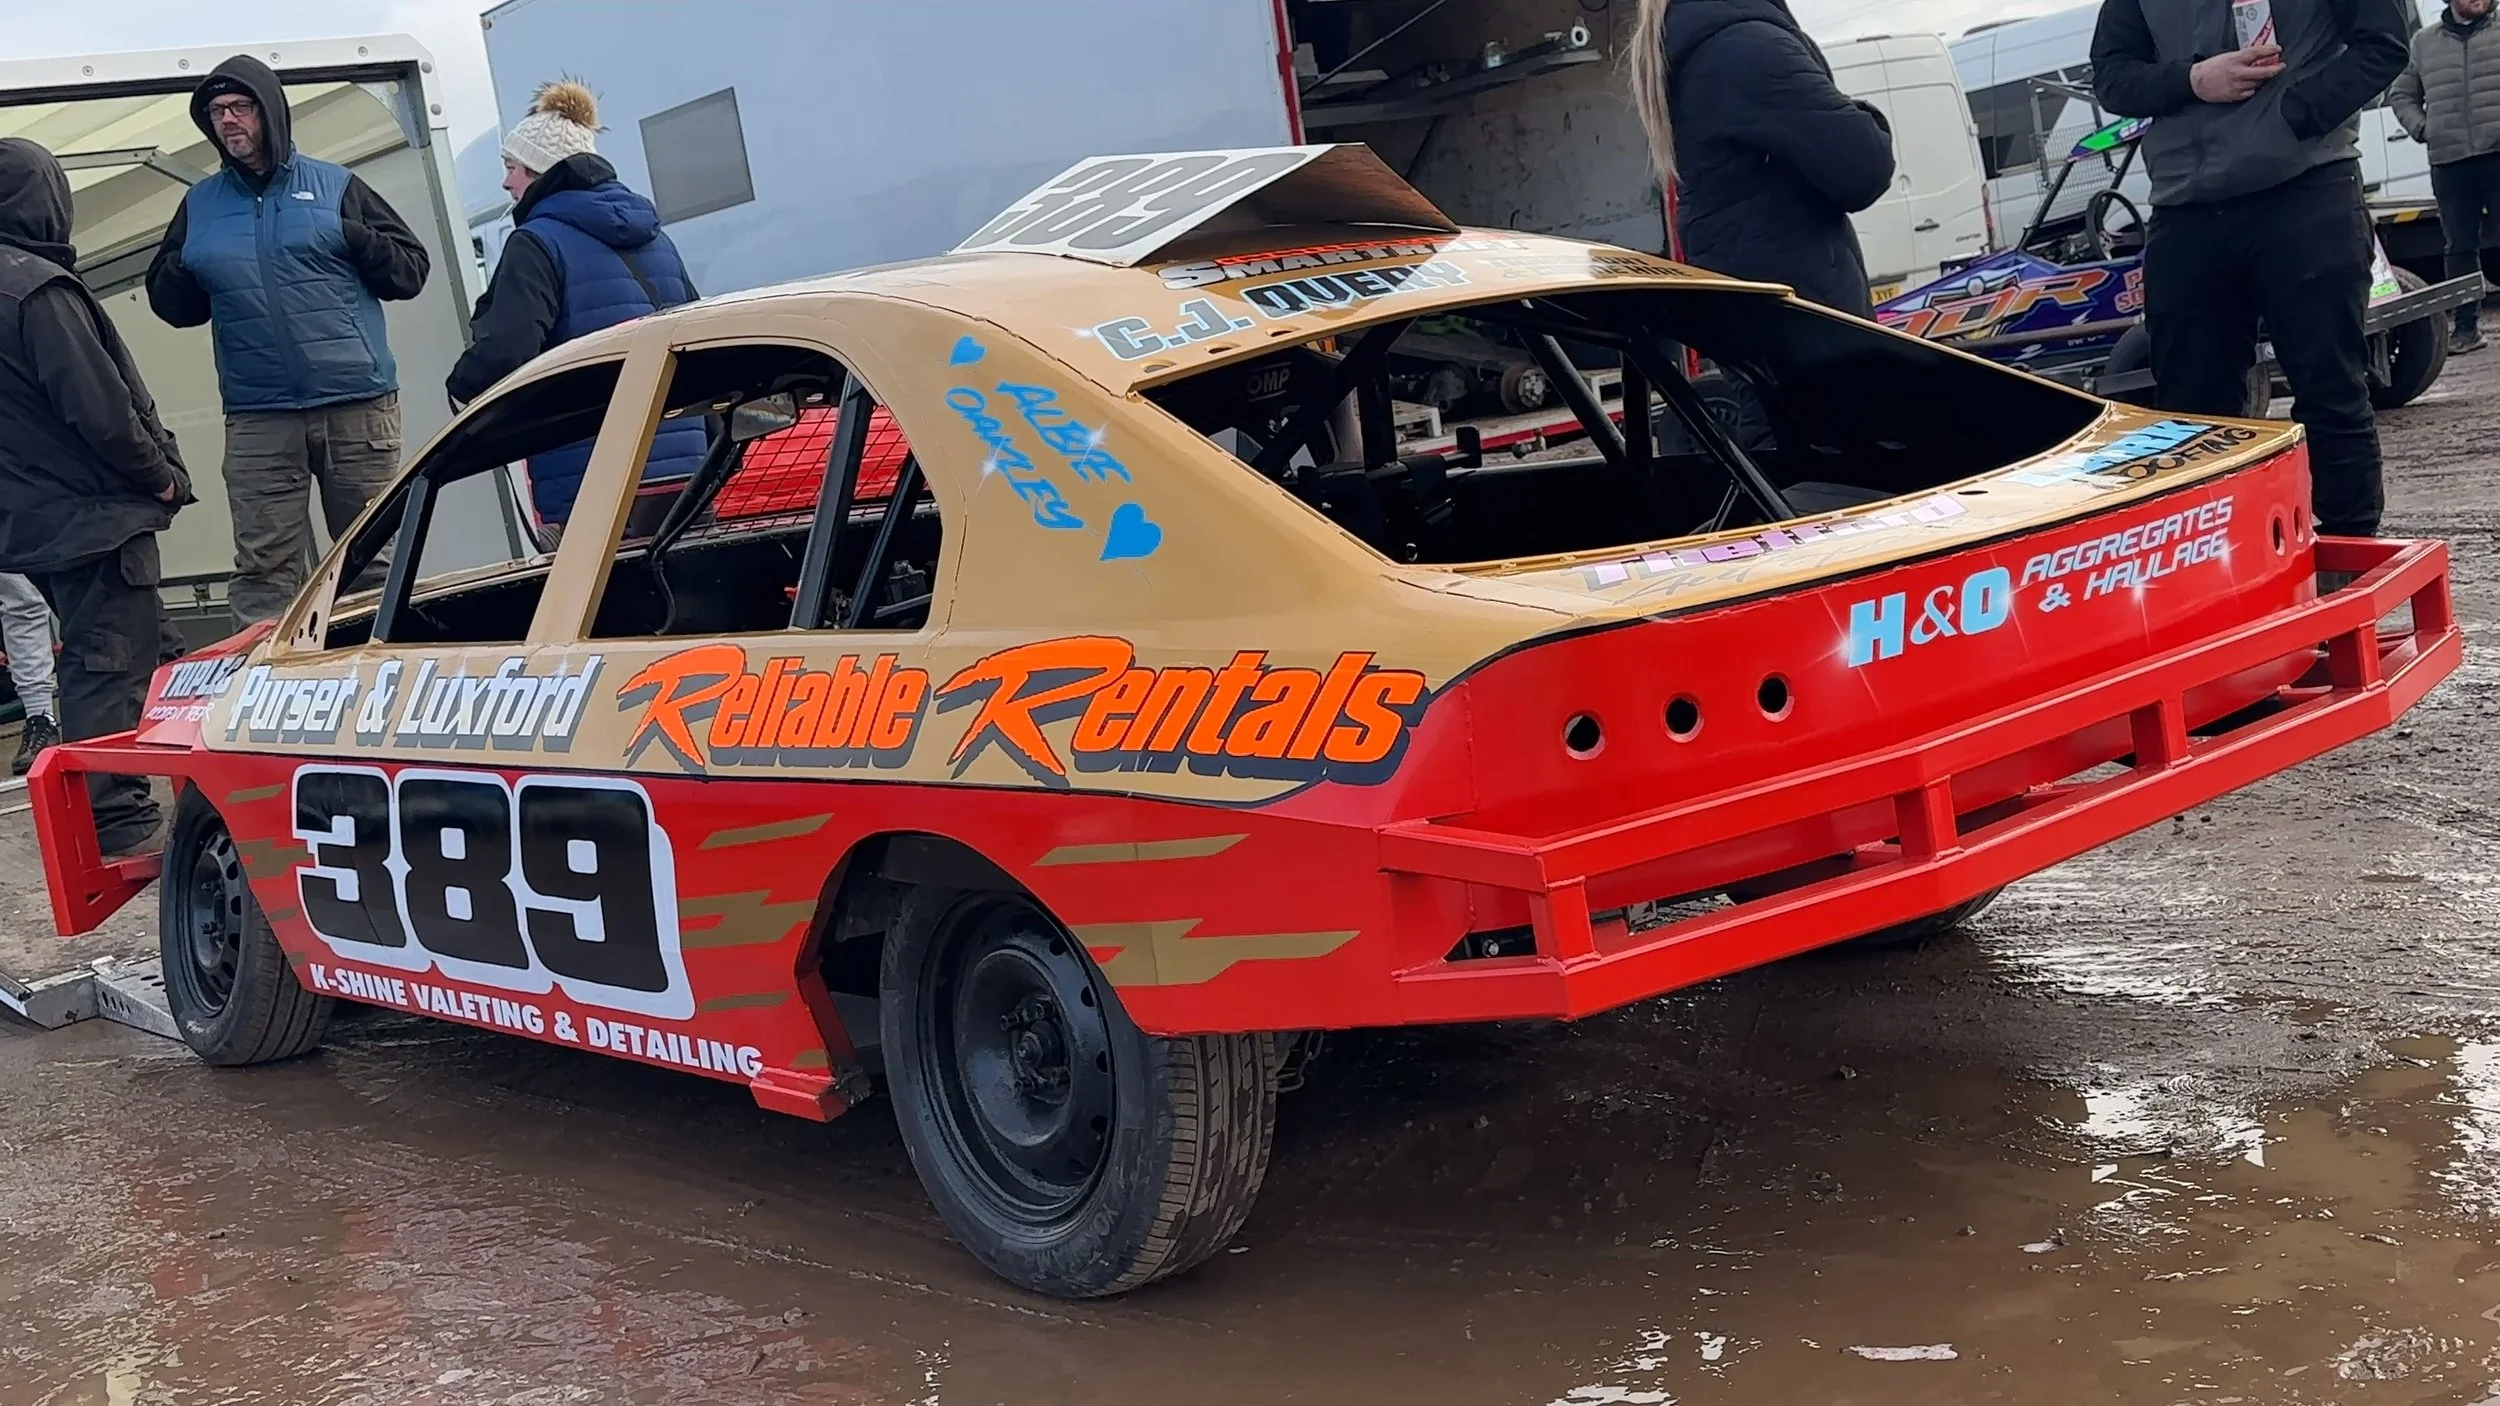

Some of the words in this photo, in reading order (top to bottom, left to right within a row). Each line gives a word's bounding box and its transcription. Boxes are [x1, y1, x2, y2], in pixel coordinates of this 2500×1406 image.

[1093, 297, 1257, 361] C.J.
[2020, 495, 2233, 586] AGGREGATES
[2038, 583, 2072, 613] &
[2083, 528, 2230, 601] HAULAGE
[225, 664, 359, 740] Purser
[355, 659, 403, 742] &
[394, 654, 605, 749] Luxford
[616, 643, 930, 772] Reliable
[936, 635, 1428, 781] Rentals
[294, 768, 678, 1000] 389
[309, 963, 409, 1006] K-SHINE
[408, 982, 545, 1035] VALETING
[553, 1011, 581, 1043] &
[586, 1017, 765, 1078] DETAILING
